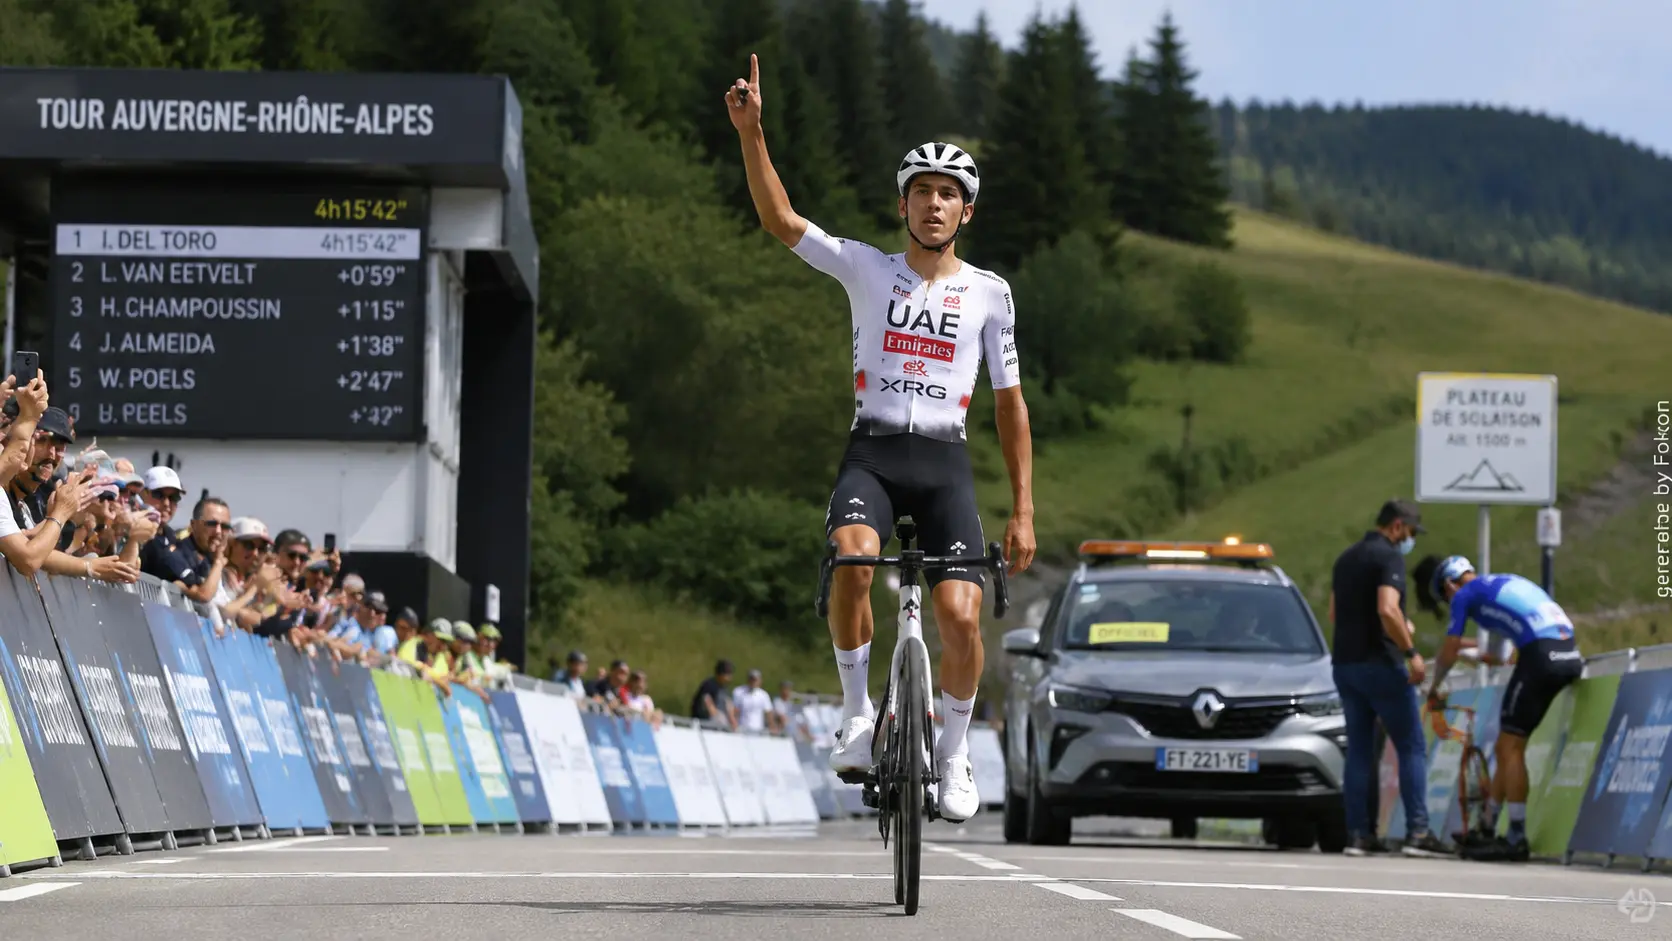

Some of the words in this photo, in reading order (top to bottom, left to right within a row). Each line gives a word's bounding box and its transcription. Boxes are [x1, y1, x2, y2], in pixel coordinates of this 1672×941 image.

[37, 98, 104, 130] TOUR
[111, 95, 434, 136] AUVERGNE-RHÔNE-ALPES
[314, 198, 407, 220] 4h15'42"
[73, 230, 81, 248] 1
[102, 231, 113, 250] I.
[118, 231, 156, 250] DEL
[161, 231, 217, 250] TORO
[320, 233, 407, 253] 4h15'42"
[71, 261, 83, 282] 2
[101, 262, 117, 283] L.
[121, 262, 164, 284] VAN
[170, 263, 257, 285] EETVELT
[338, 265, 405, 286] +0'59"
[70, 297, 82, 317] 3
[101, 297, 120, 318] H.
[125, 297, 281, 319] CHAMPOUSSIN
[338, 300, 404, 321] +1'15"
[887, 299, 960, 339] UAE
[69, 332, 82, 351] 4
[100, 332, 115, 353] J.
[120, 333, 216, 354] ALMEIDA
[337, 335, 404, 357] +1'38"
[886, 335, 953, 358] Emirates
[69, 367, 82, 388] 5
[99, 368, 124, 388] W.
[129, 368, 196, 390] POELS
[337, 370, 404, 392] +2'47"
[880, 377, 947, 400] XRG
[1447, 388, 1526, 408] PLATEAU
[1432, 409, 1452, 428] DE
[1167, 750, 1247, 770] FT-221-YE
